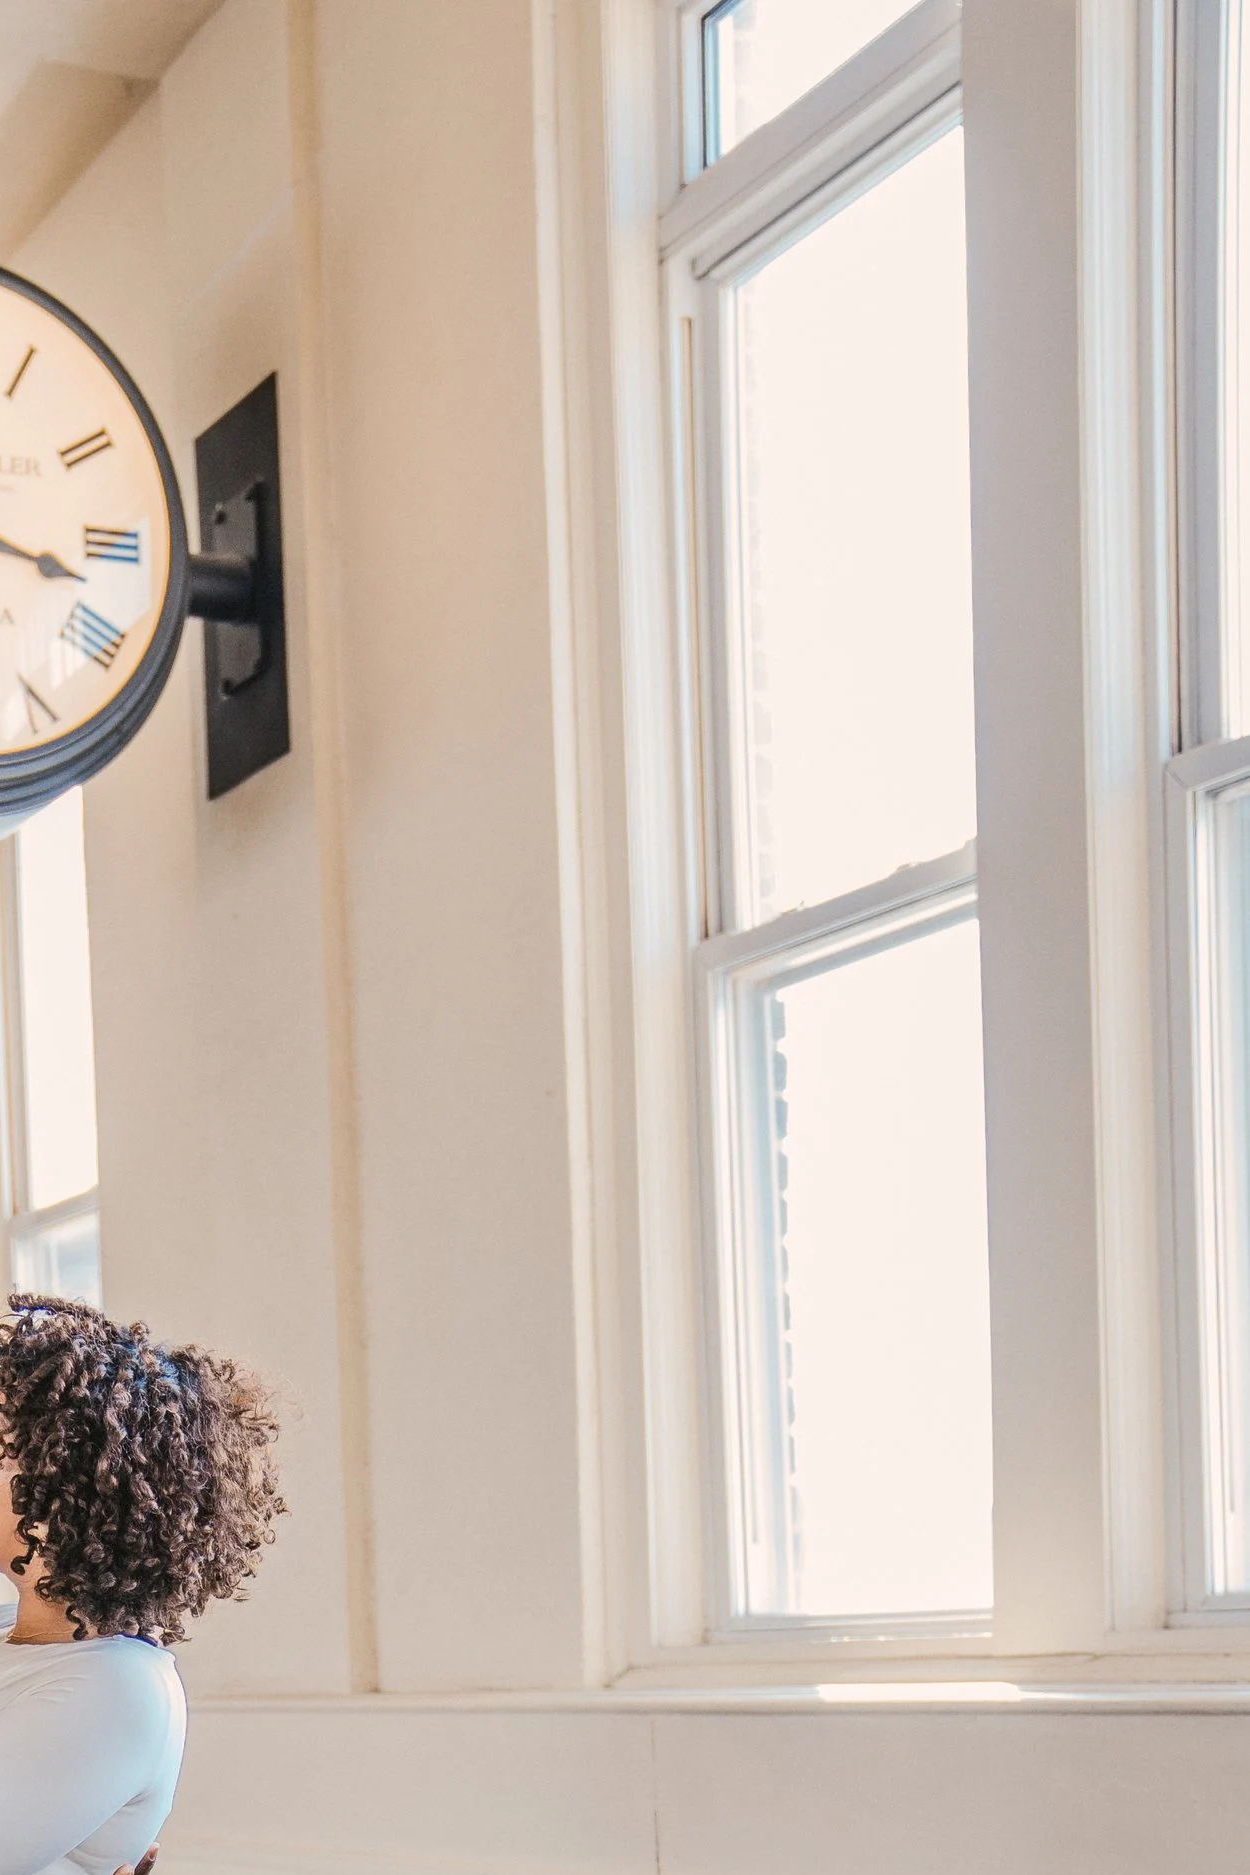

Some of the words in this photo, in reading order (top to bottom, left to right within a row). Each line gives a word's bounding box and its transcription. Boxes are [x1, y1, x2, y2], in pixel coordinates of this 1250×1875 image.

[58, 427, 113, 470] II
[84, 524, 140, 564] III
[16, 670, 61, 735] V
